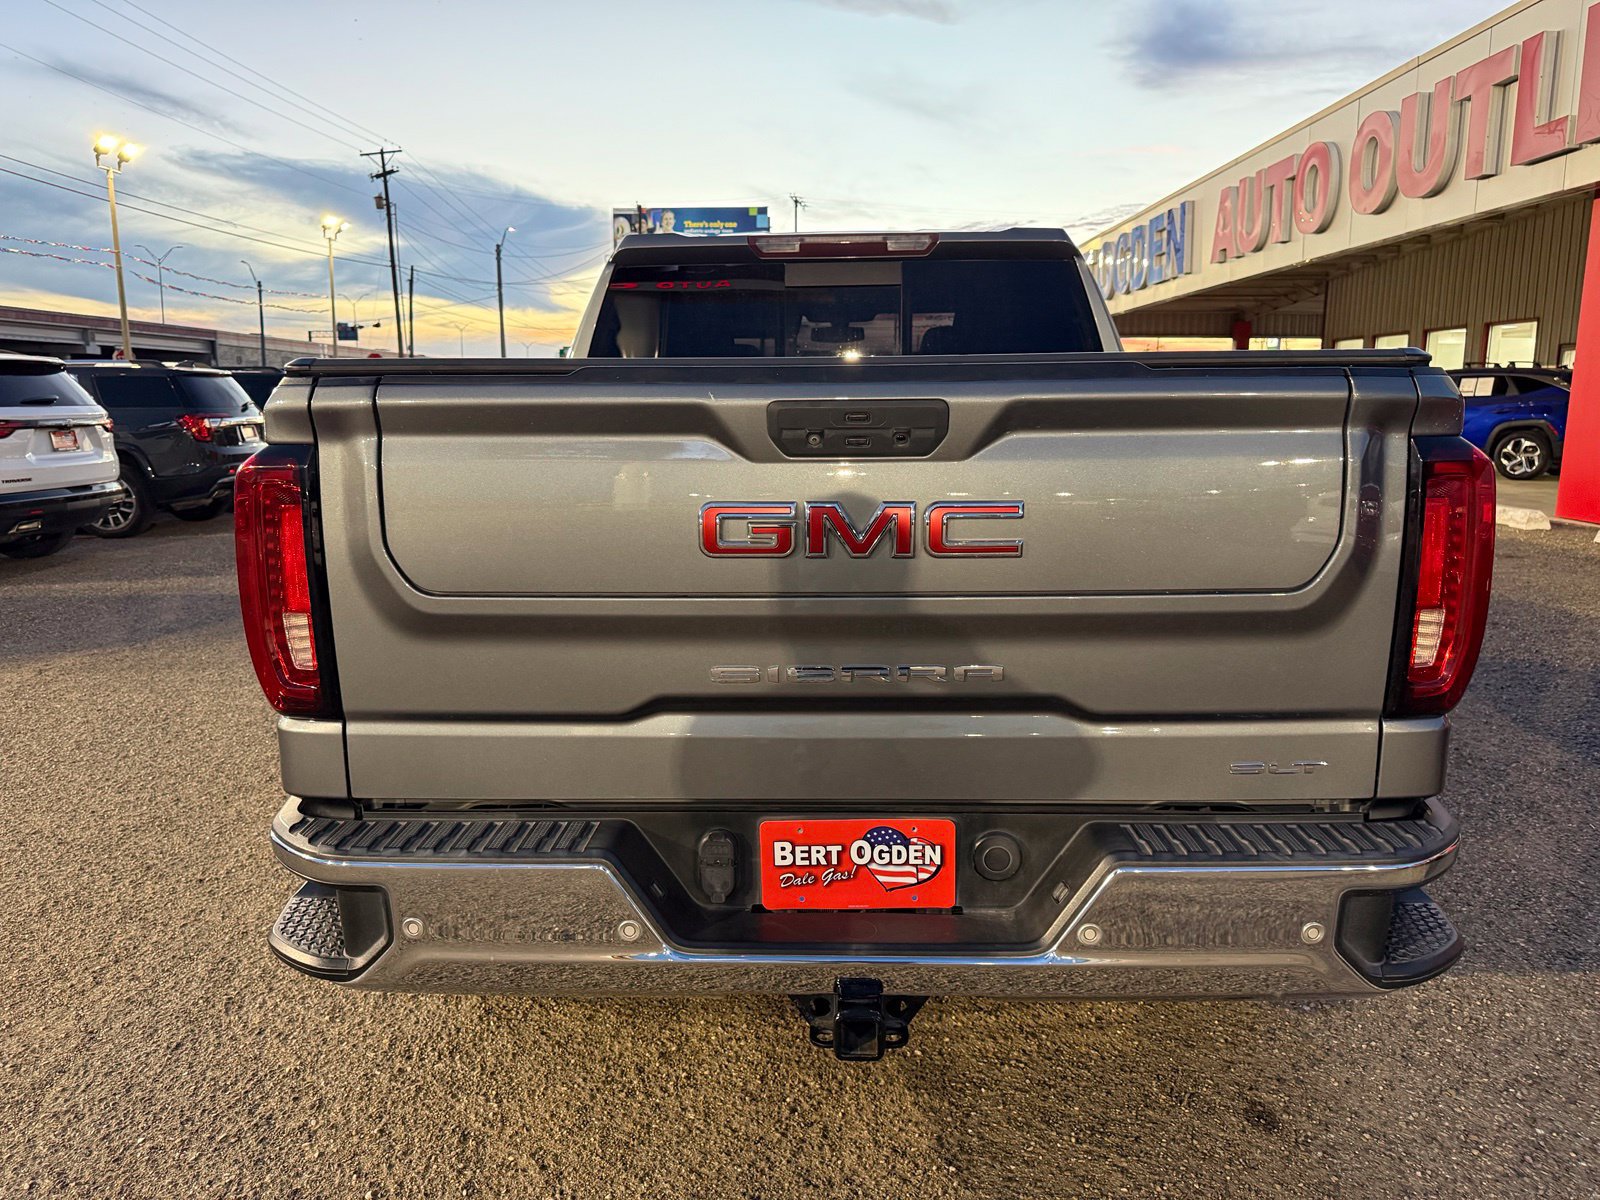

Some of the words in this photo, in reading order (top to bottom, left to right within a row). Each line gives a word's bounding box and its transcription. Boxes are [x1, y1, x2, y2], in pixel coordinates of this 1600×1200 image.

[1210, 141, 1340, 263] AUTO
[699, 500, 1025, 559] GMC
[710, 664, 1005, 684] SIERRA
[1229, 760, 1329, 775] SLT
[773, 841, 842, 866] BERT
[849, 839, 942, 866] OGDEN
[779, 872, 816, 889] Dale
[821, 864, 858, 888] Gas!
